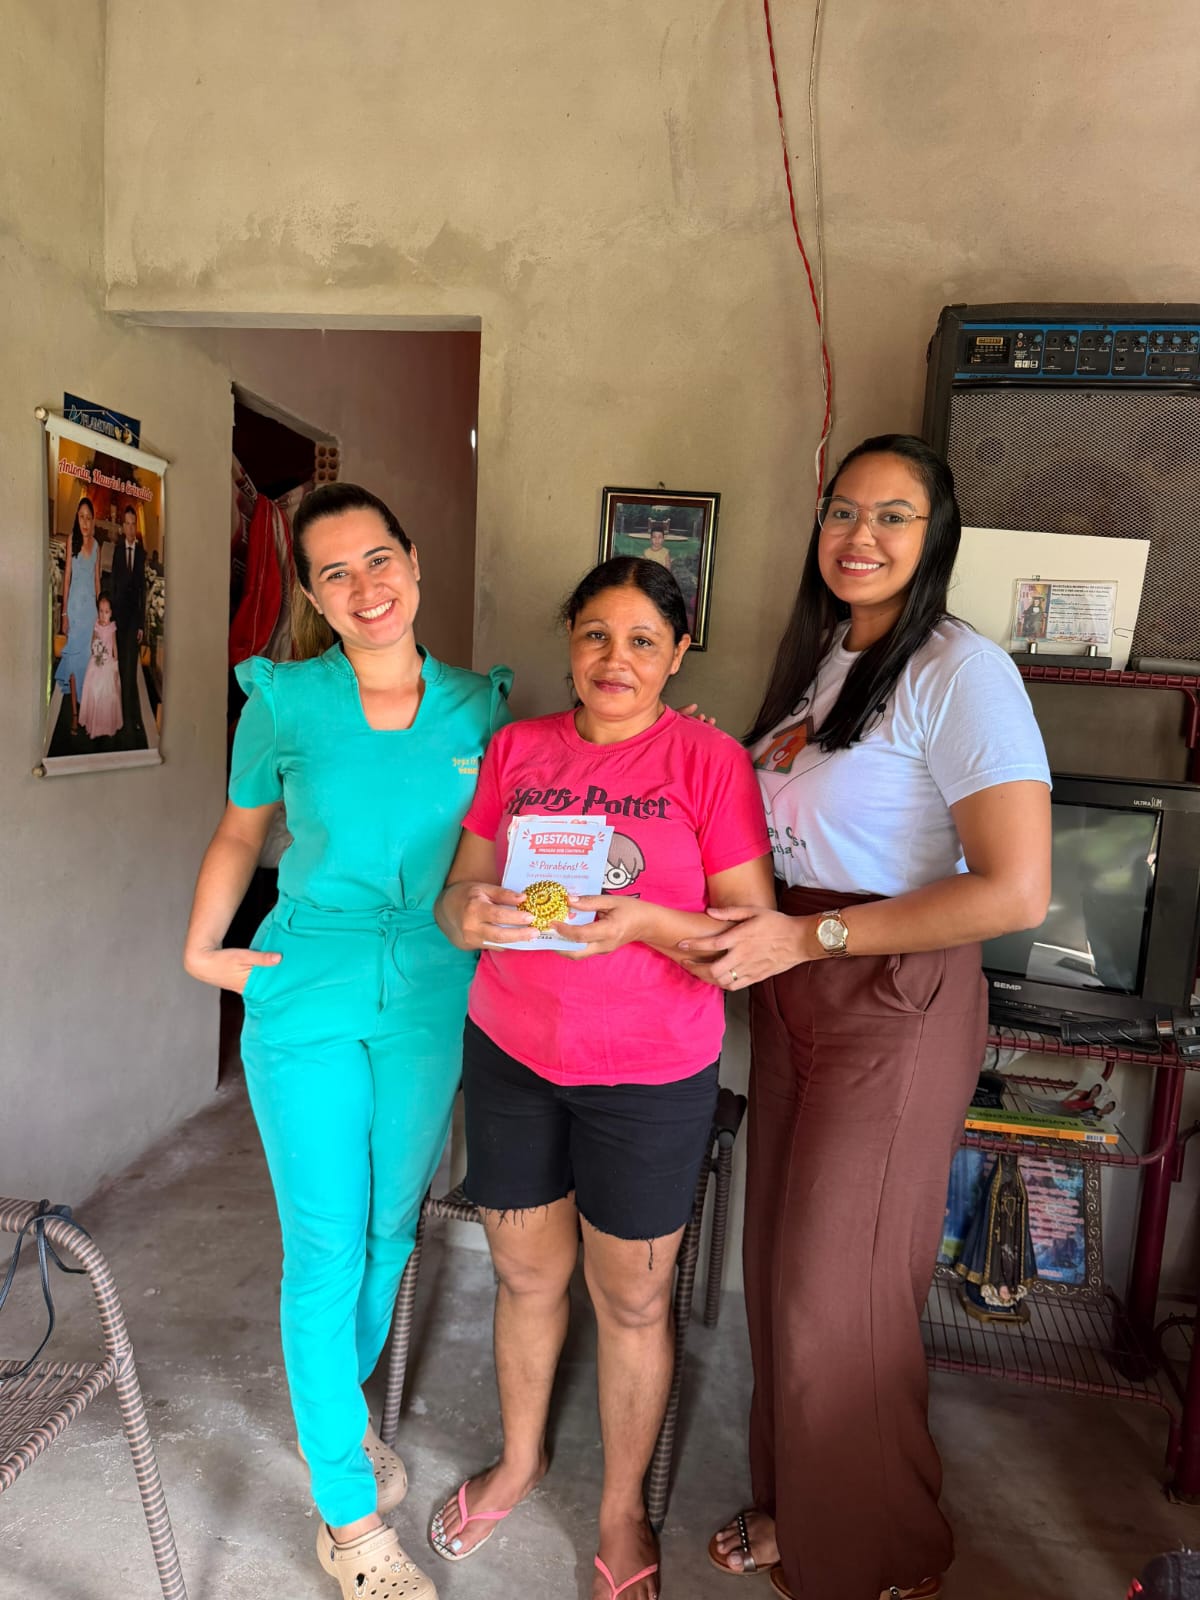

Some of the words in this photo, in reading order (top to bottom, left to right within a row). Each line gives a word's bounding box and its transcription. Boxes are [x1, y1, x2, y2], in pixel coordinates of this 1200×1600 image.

[507, 787, 581, 815] Harry
[582, 785, 672, 820] Potter
[535, 833, 591, 847] DESTAQUE
[539, 860, 579, 871] Parabéns!
[993, 981, 1022, 991] SEMP
